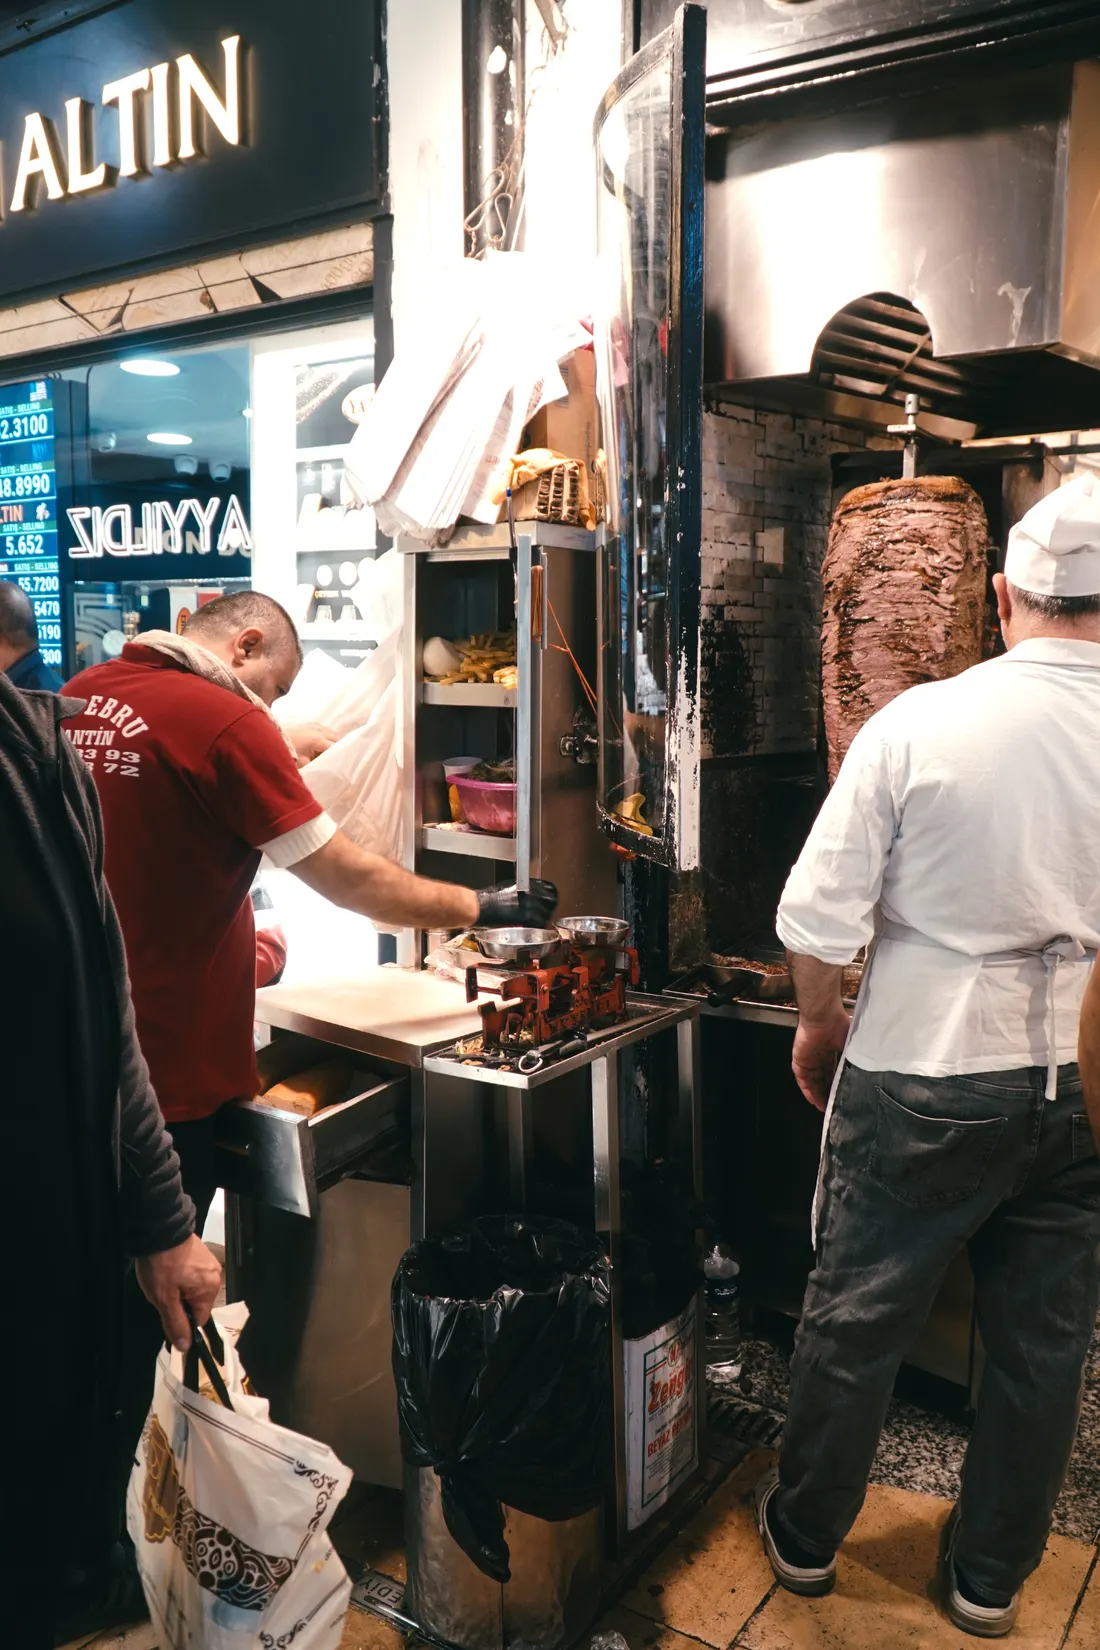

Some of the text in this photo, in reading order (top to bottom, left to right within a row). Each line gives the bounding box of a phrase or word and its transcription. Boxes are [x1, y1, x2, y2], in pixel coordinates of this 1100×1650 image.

[10, 34, 241, 212] ALTIN
[0, 413, 48, 439] 2.3100
[6, 534, 44, 556] 5.652
[39, 648, 62, 665] 300
[84, 695, 149, 738] EBRU
[105, 749, 141, 763] 93
[103, 762, 140, 778] 72
